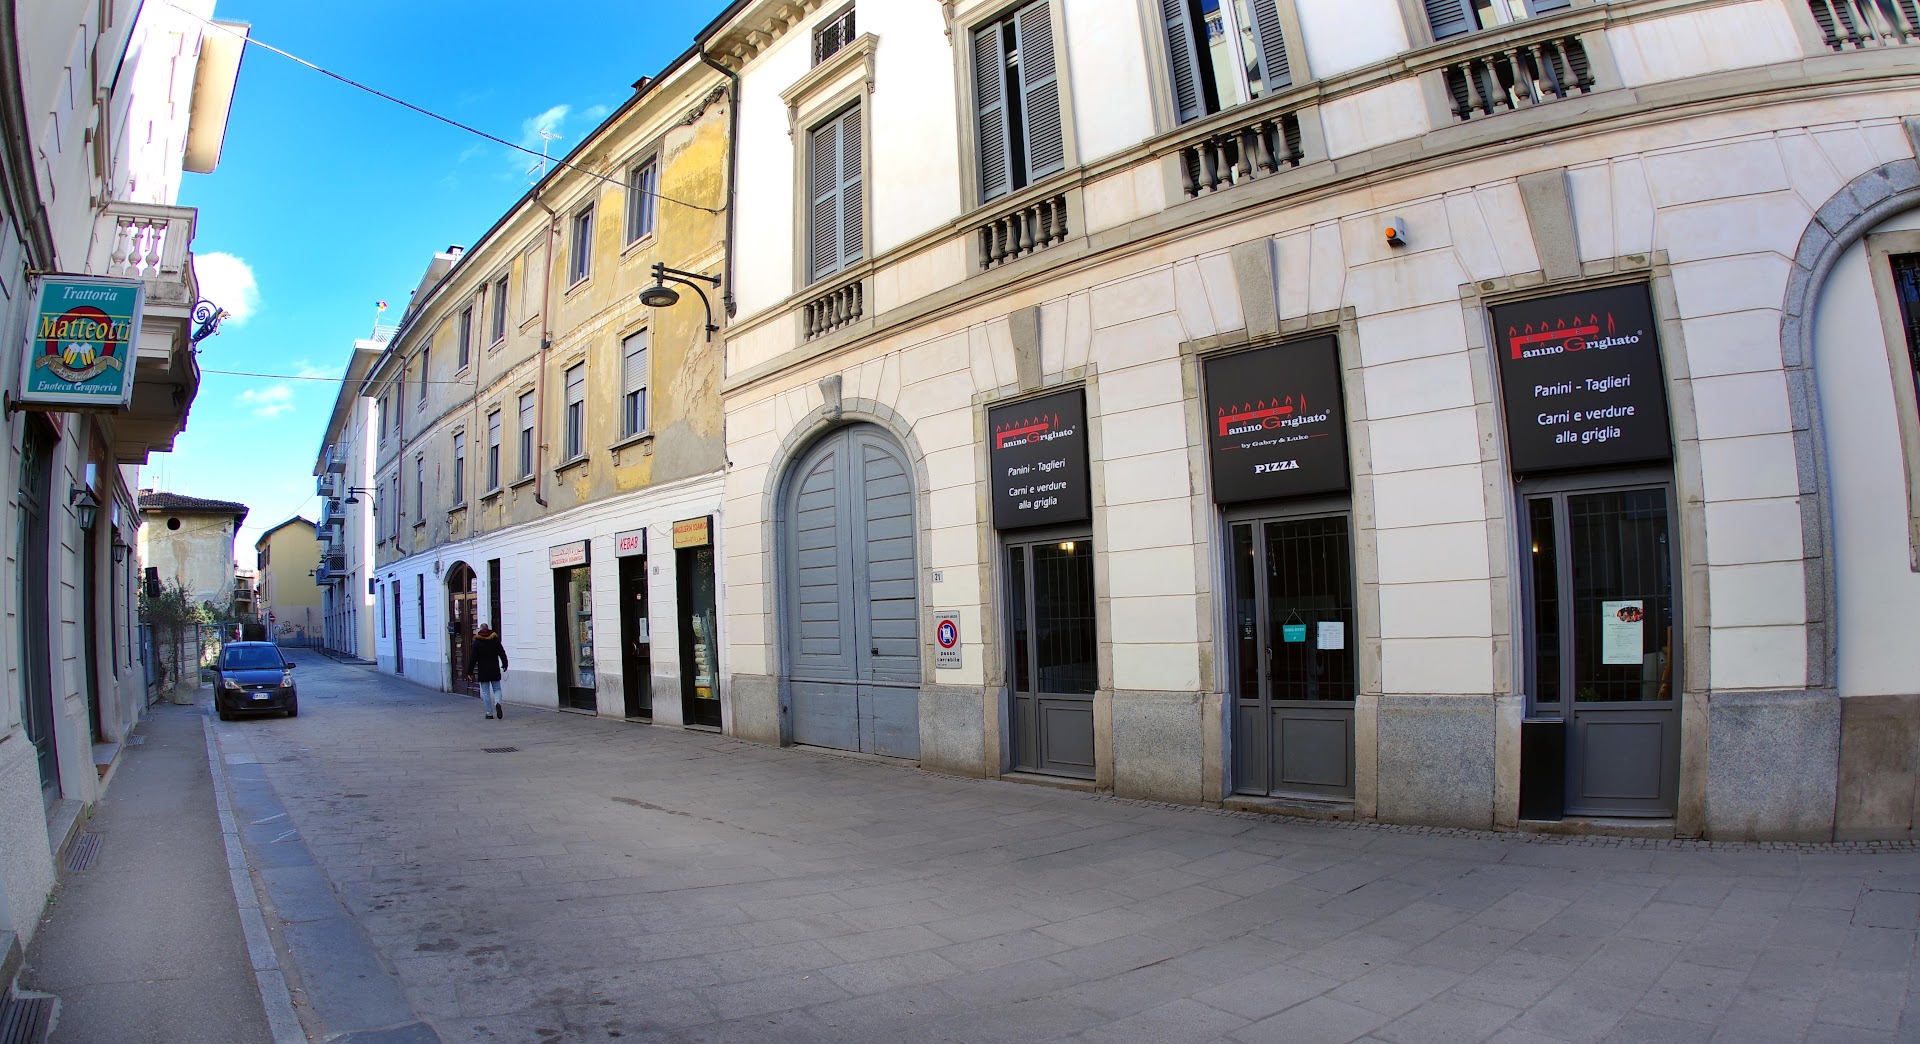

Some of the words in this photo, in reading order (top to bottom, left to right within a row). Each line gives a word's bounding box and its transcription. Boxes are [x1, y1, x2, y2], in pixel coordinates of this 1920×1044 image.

[63, 286, 117, 301] Trattoria
[37, 316, 131, 340] Matteotti
[37, 381, 71, 392] Enoteca
[74, 382, 117, 394] Grapperia
[1534, 381, 1572, 398] Panini
[1585, 374, 1631, 392] Taglieri
[1537, 410, 1570, 425] Carni
[1573, 411, 1582, 422] e
[1586, 405, 1635, 420] verdure
[1252, 438, 1277, 447] Gabry
[1287, 434, 1309, 442] Luke
[1555, 430, 1577, 443] alla
[1581, 426, 1621, 444] griglia
[1008, 464, 1030, 476] Panini
[1037, 458, 1066, 472] Taglieri
[1254, 459, 1300, 474] PIZZA
[1009, 485, 1028, 497] Carni
[1029, 486, 1035, 494] e
[1036, 481, 1067, 493] verdure
[1018, 500, 1032, 510] alla
[1033, 496, 1058, 510] griglia
[620, 536, 638, 551] KEBAB
[934, 573, 941, 581] 21
